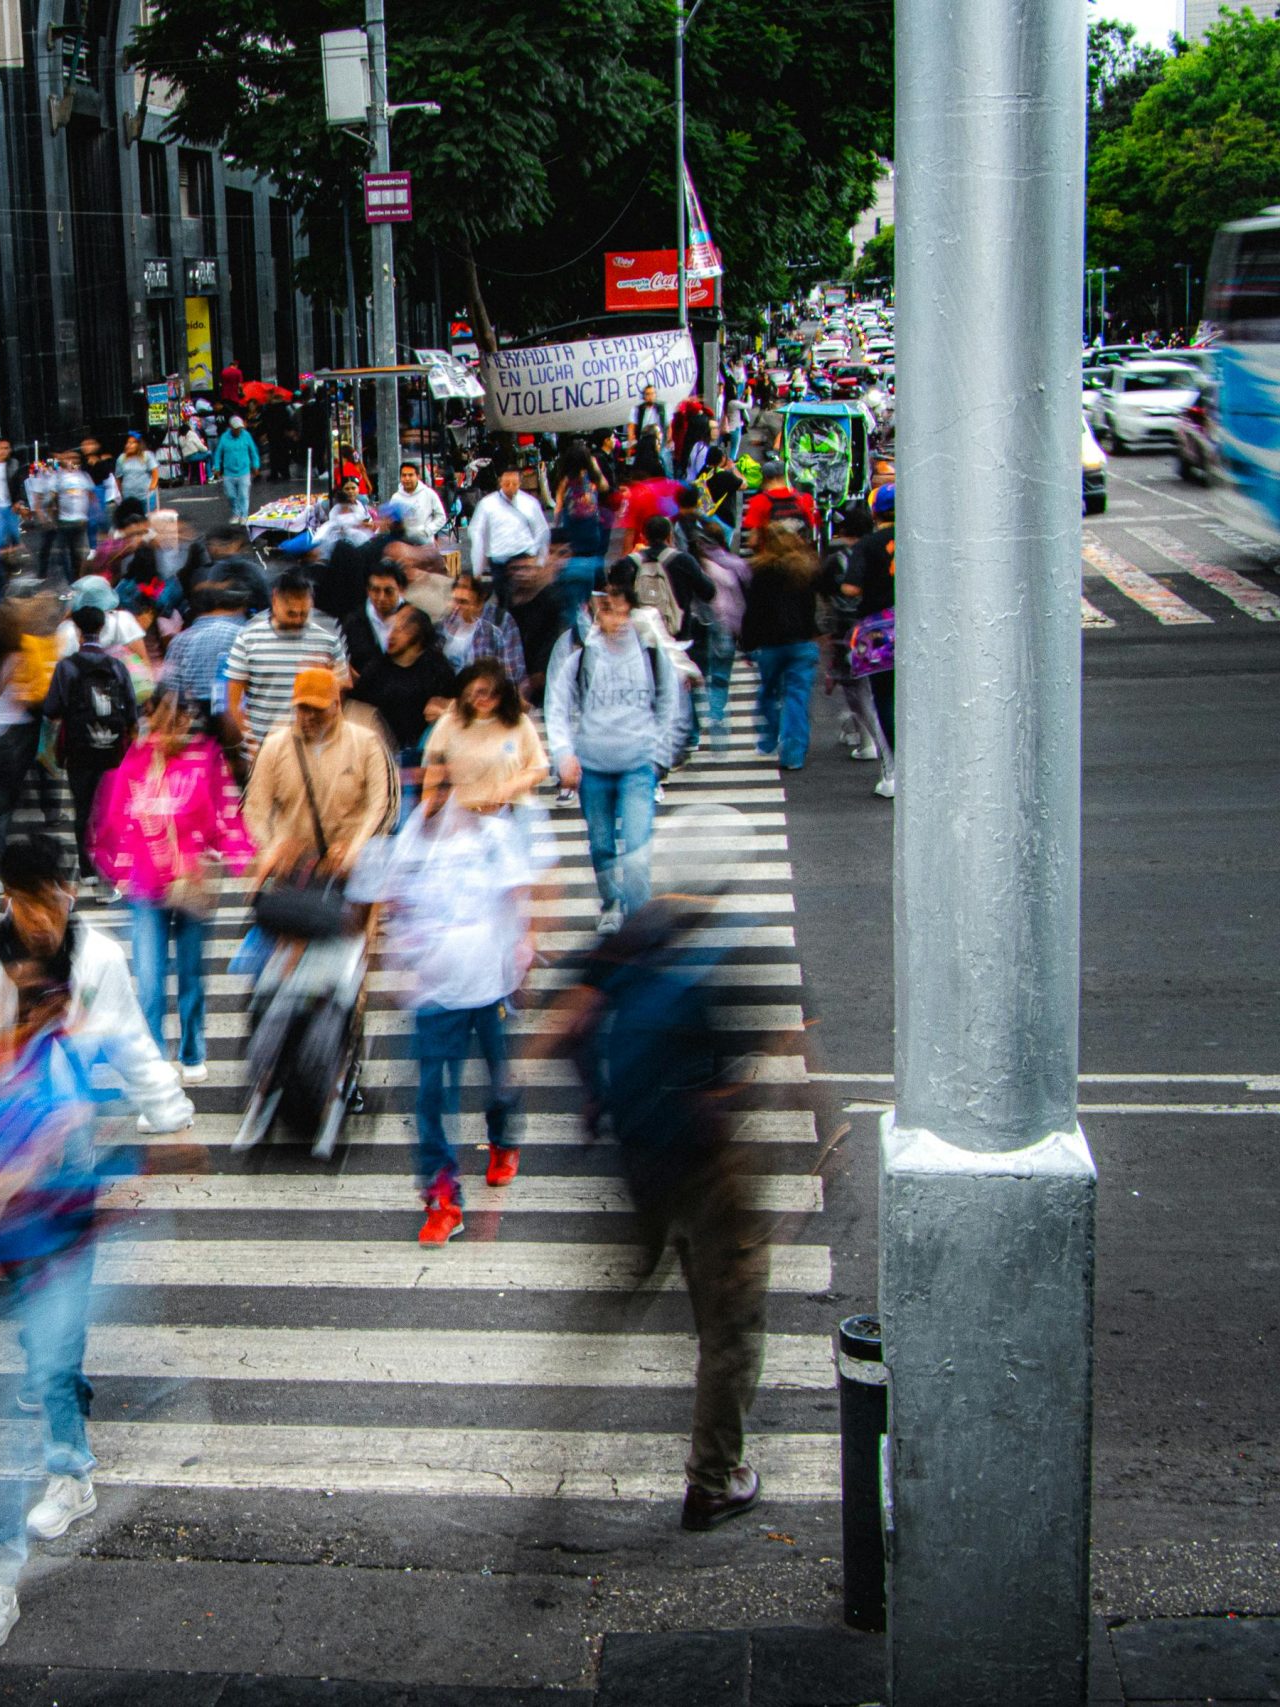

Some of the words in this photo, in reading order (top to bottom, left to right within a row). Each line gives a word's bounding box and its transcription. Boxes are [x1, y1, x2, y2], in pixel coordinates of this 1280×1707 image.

[589, 331, 683, 358] FEMINISTA
[499, 371, 521, 388] EN
[529, 363, 574, 385] LUCHA
[582, 352, 638, 378] CONTRA
[496, 378, 620, 416] VIOLENCIA
[591, 690, 650, 709] NIKE
